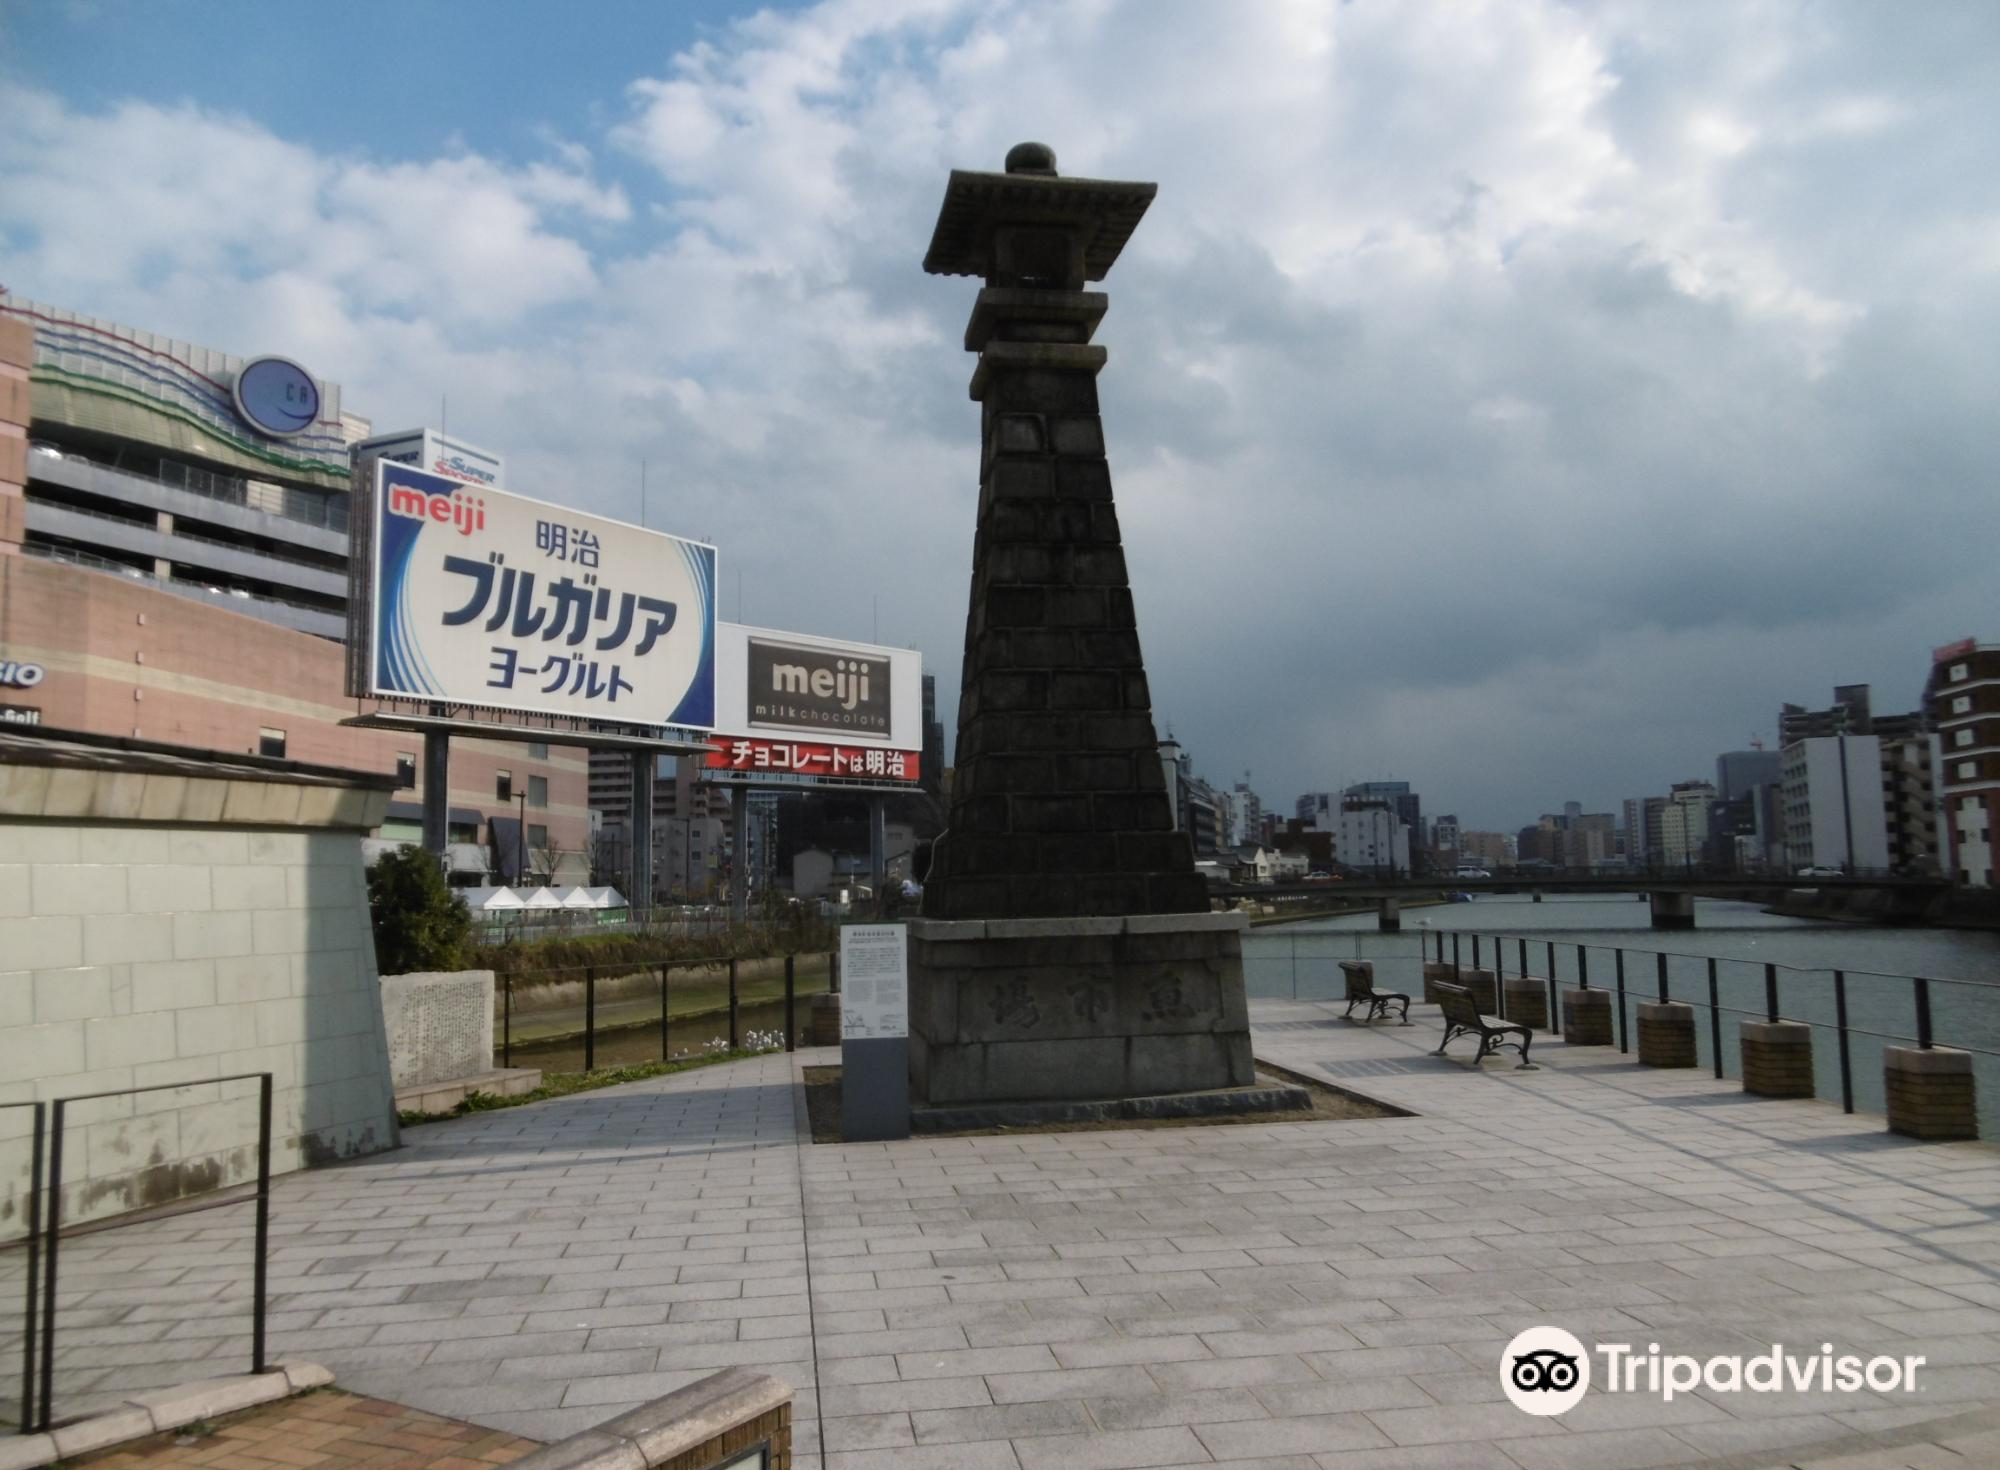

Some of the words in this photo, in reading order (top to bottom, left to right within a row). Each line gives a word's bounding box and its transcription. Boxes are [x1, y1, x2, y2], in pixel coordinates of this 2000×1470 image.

[391, 485, 485, 536] meiji
[536, 520, 601, 569] 明治
[442, 551, 678, 657] ブルガリア
[486, 646, 634, 702] ヨーグルト
[772, 659, 870, 710] meiji
[731, 741, 906, 776] チョコレートは明治
